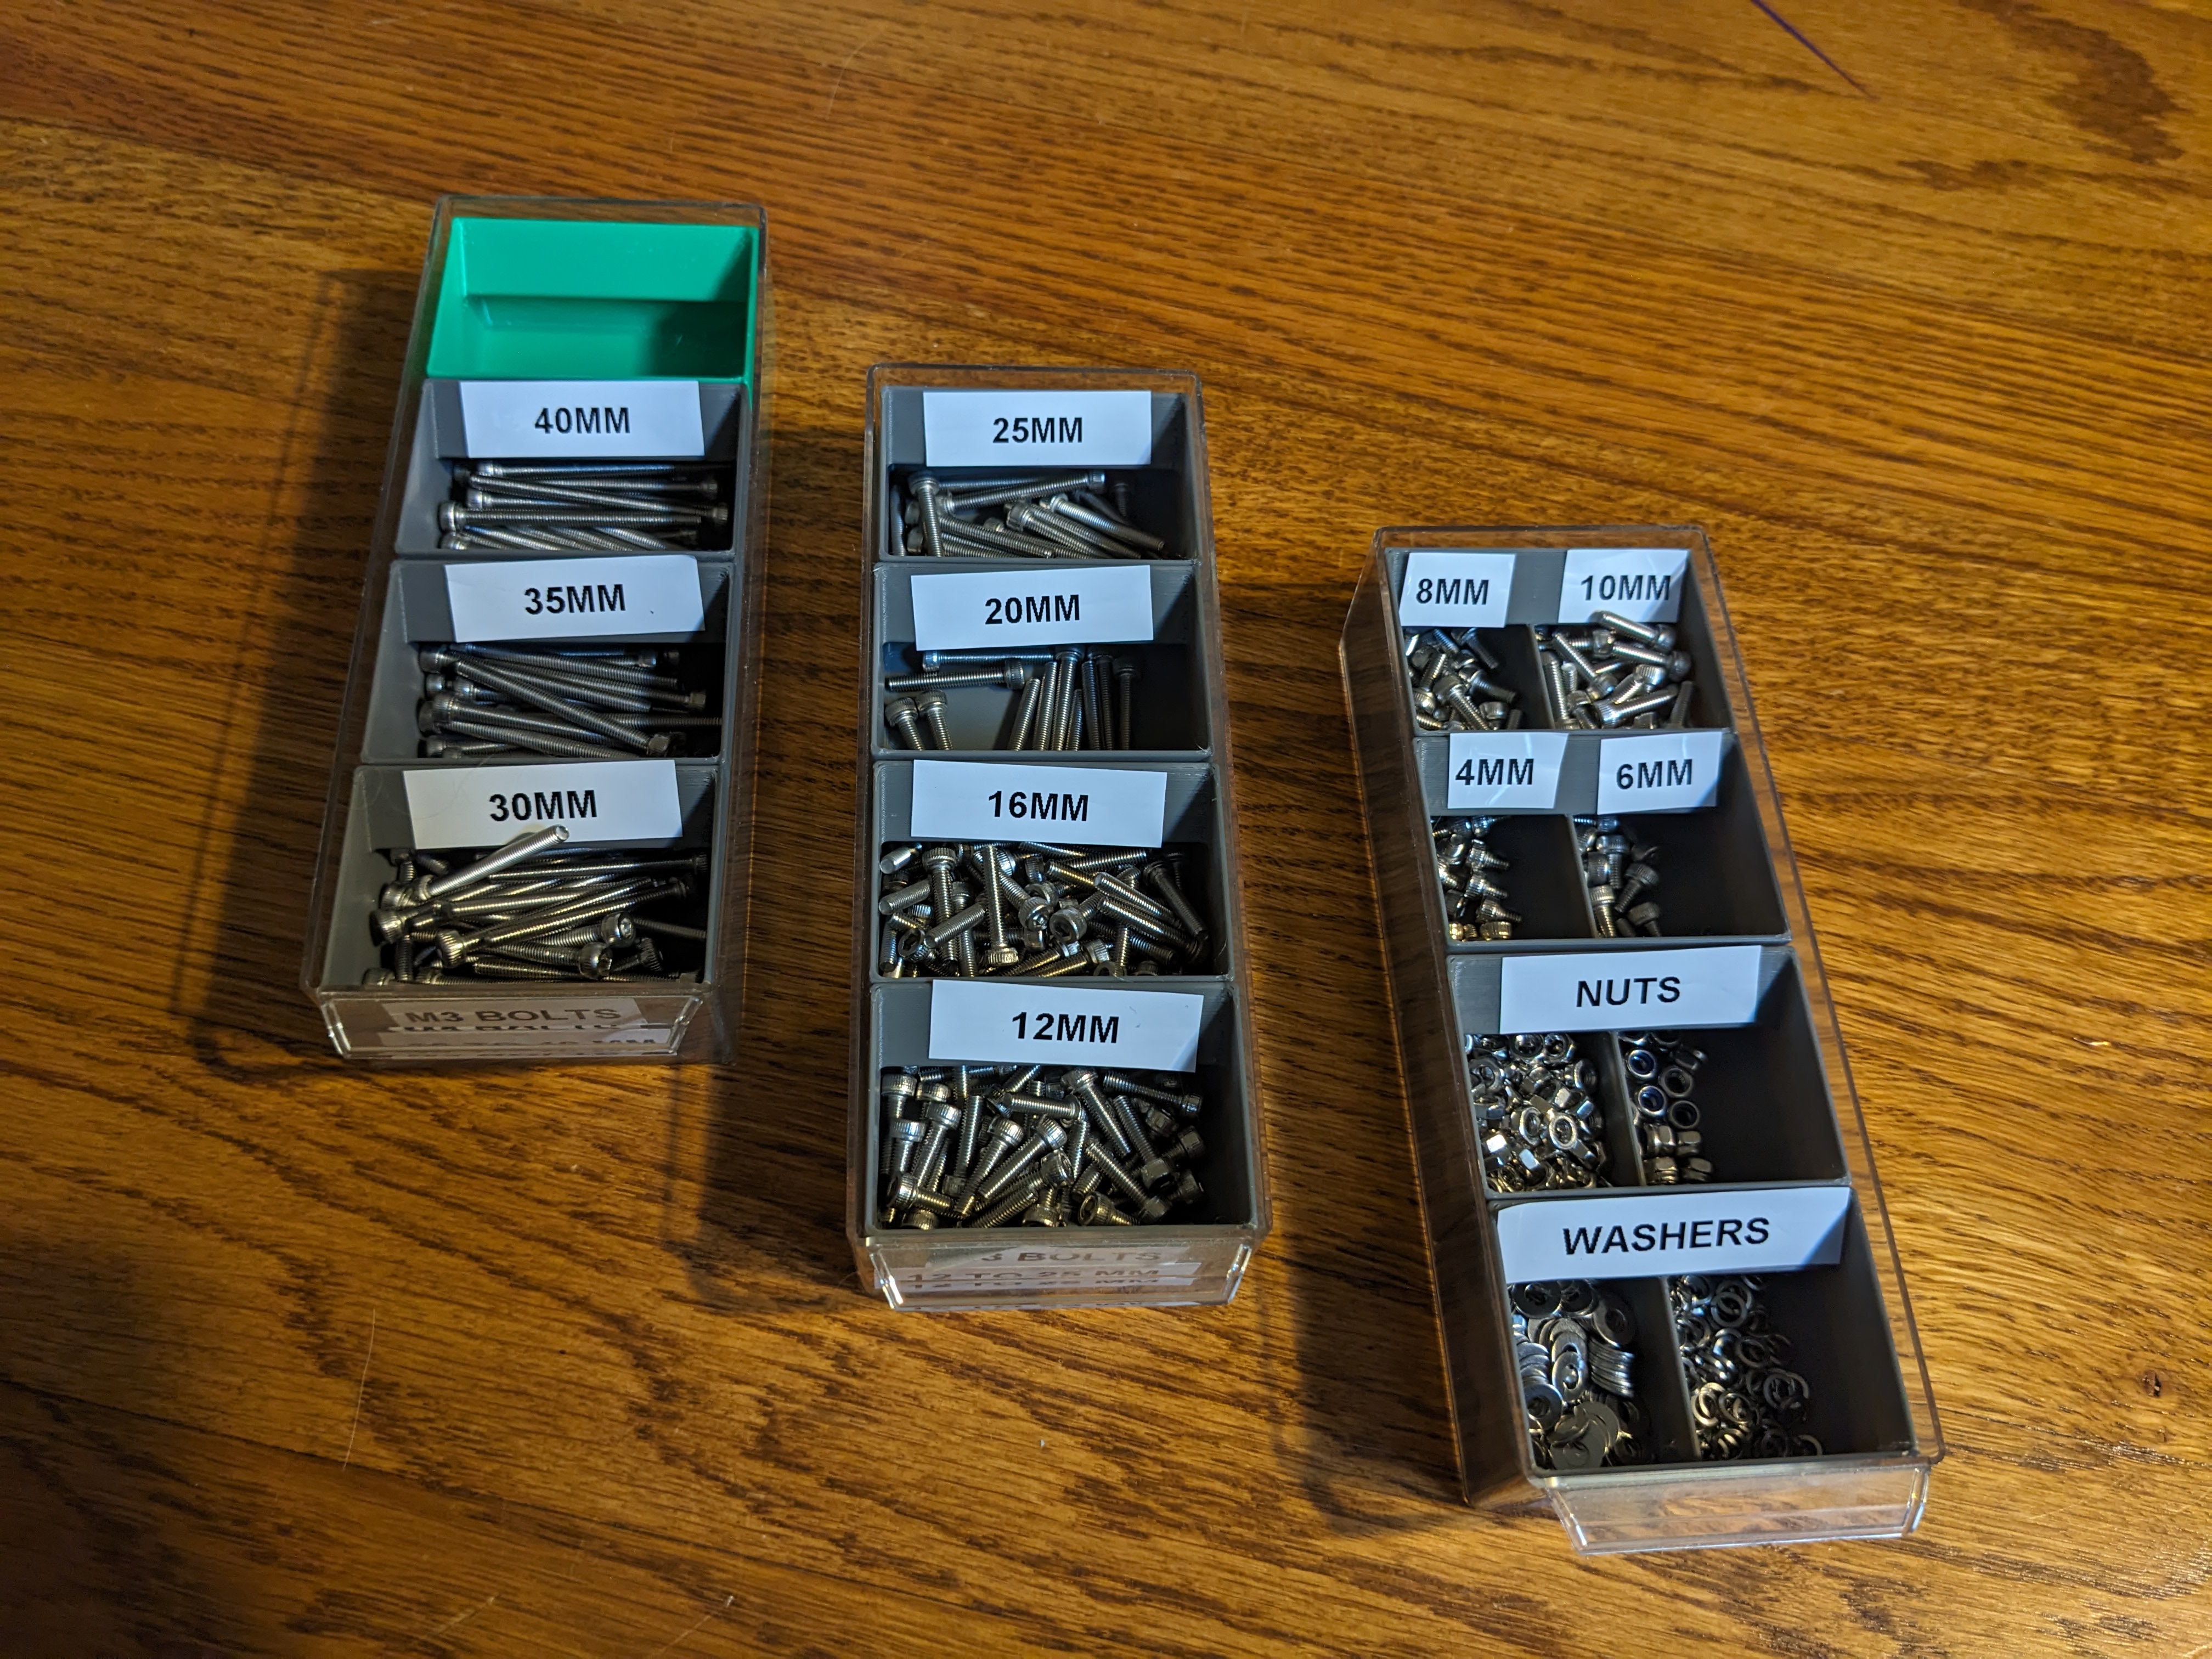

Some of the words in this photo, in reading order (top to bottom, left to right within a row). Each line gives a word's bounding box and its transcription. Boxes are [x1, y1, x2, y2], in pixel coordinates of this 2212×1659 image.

[534, 407, 630, 434] 40MM
[992, 417, 1083, 443] 25MM
[524, 584, 626, 615] 35MM
[1415, 578, 1489, 605] 8MM
[1581, 574, 1671, 601] 10MM
[985, 594, 1080, 625] 20MM
[1455, 758, 1534, 786] 4MM
[1616, 758, 1693, 790] 6MM
[489, 789, 597, 822] 30MM
[988, 791, 1089, 821] 16MM
[1576, 976, 1681, 1007] NUTS
[404, 1012, 464, 1023] M3
[475, 1008, 622, 1022] BOLTS
[1012, 1012, 1119, 1043] 12MM
[1562, 1217, 1770, 1255] WASHERS
[1017, 1251, 1161, 1262] BOLTS
